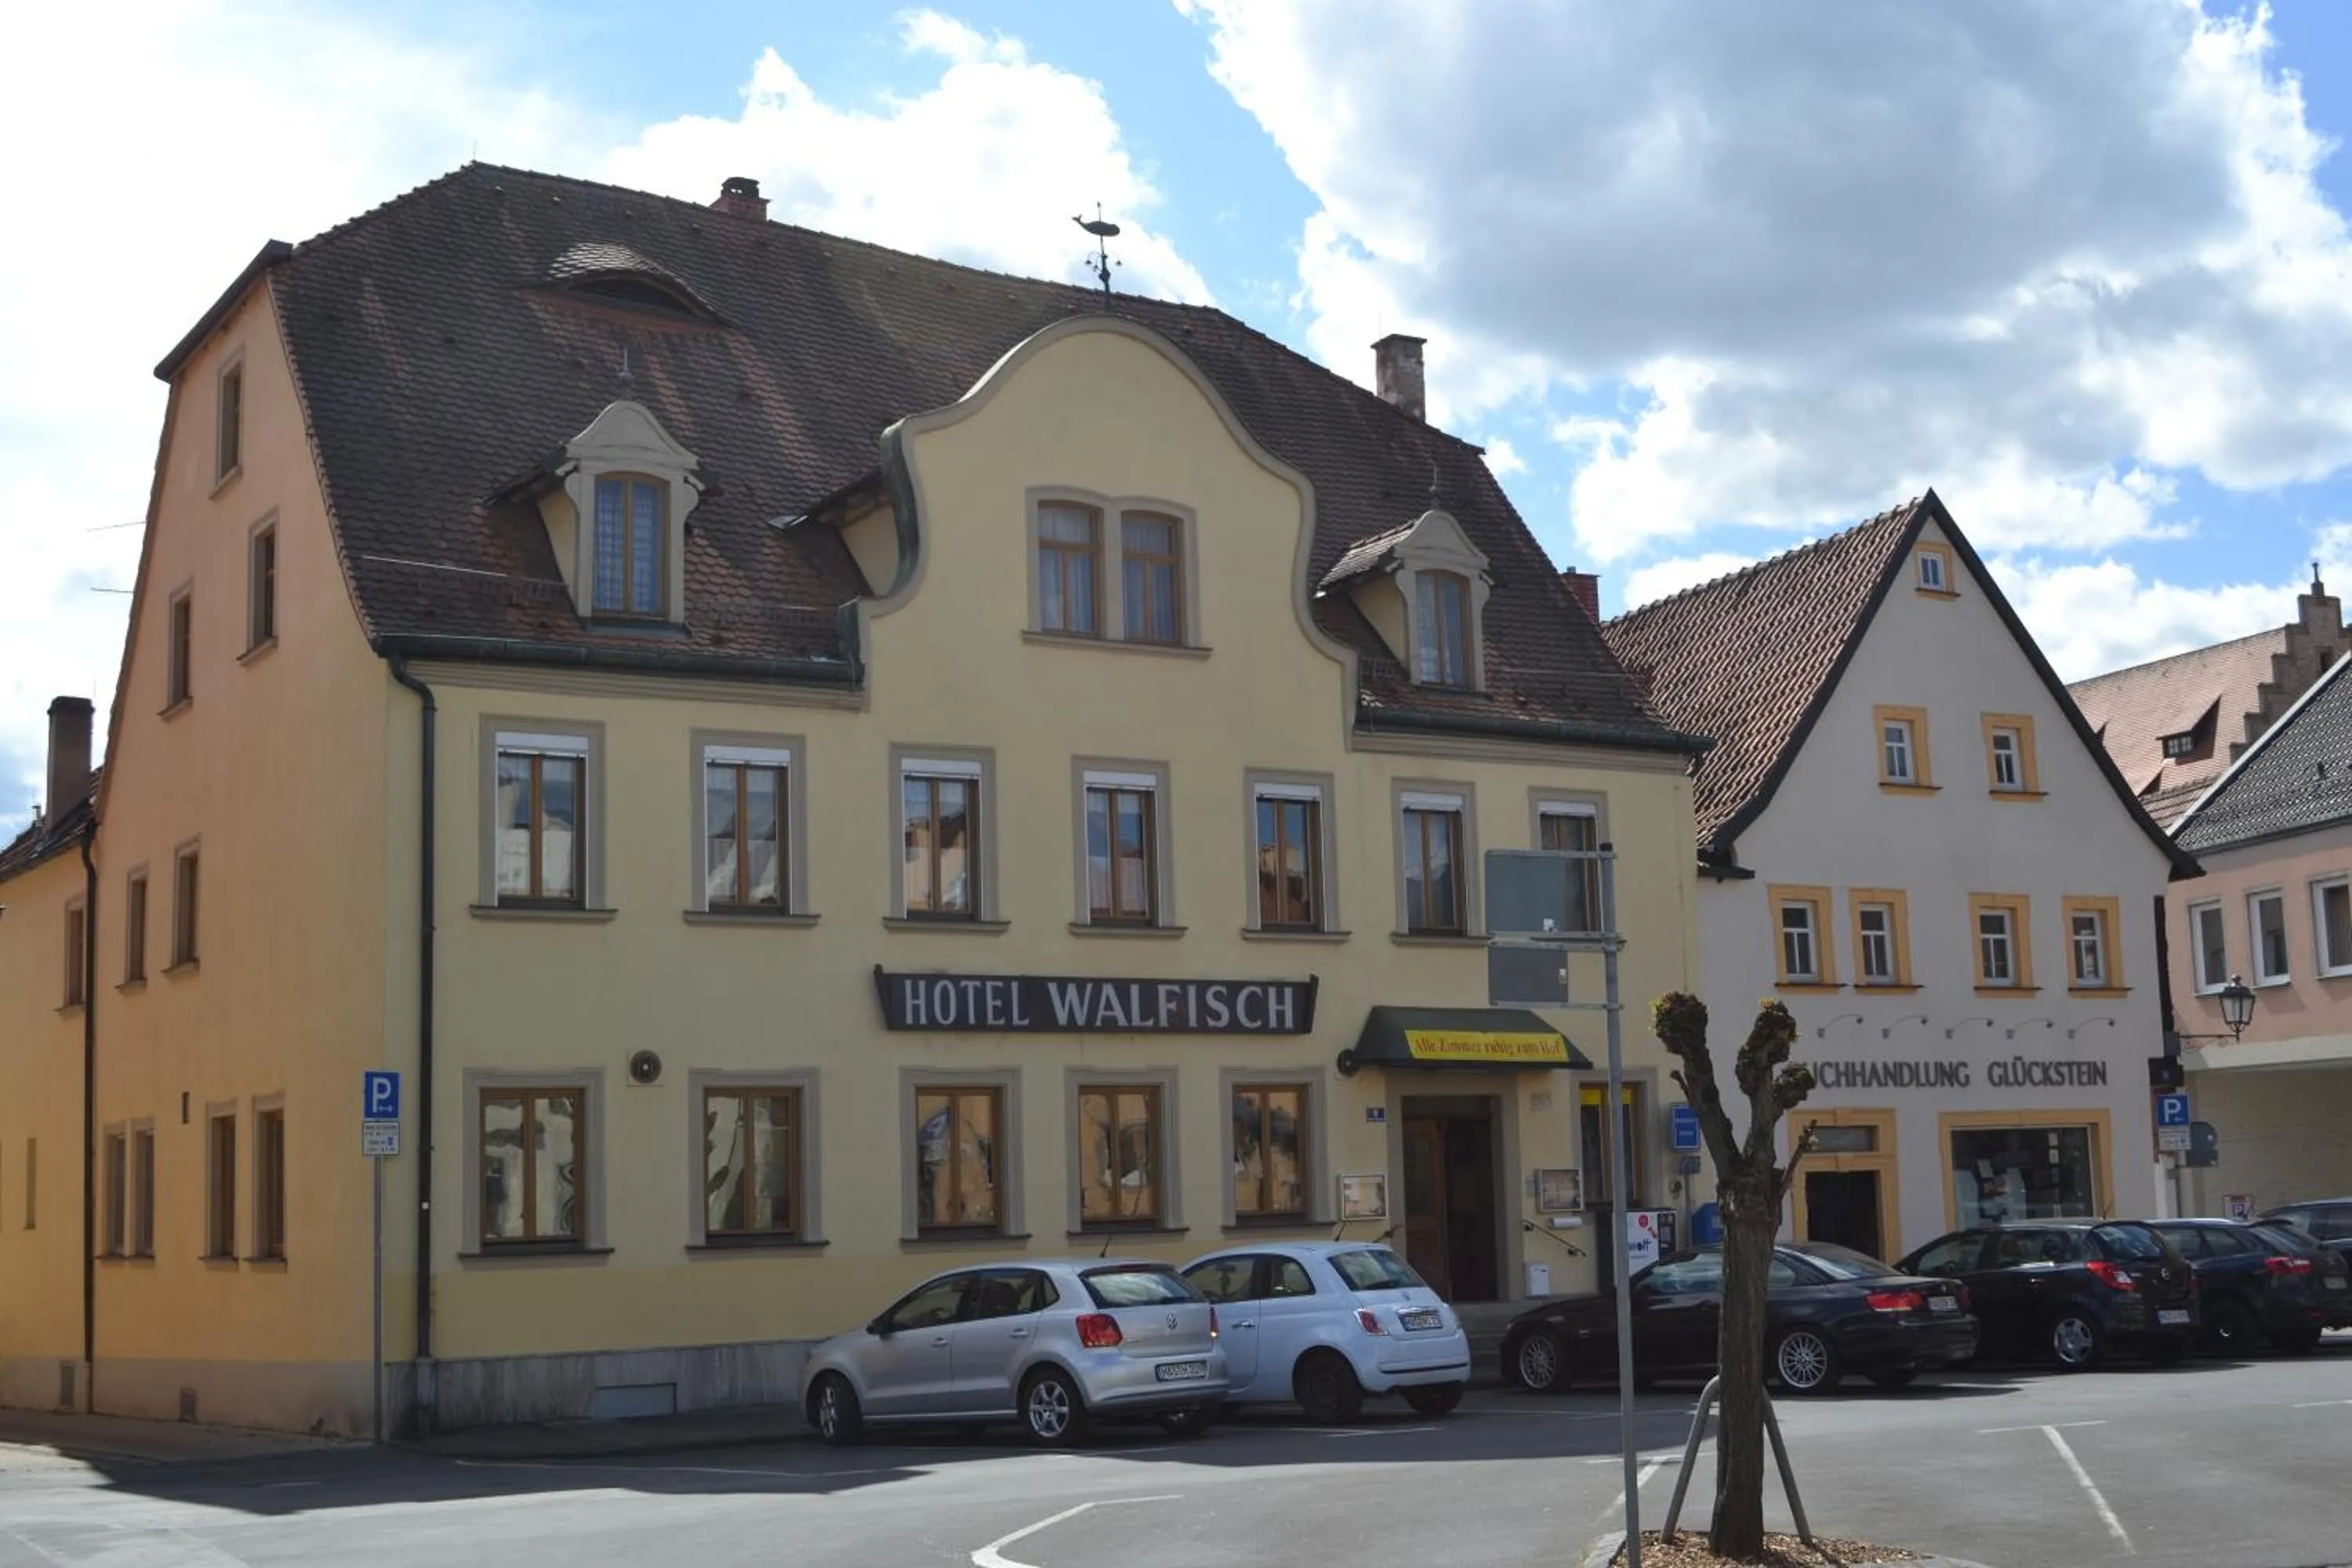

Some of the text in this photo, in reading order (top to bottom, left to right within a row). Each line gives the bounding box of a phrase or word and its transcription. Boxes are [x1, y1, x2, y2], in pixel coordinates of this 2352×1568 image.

[904, 979, 1294, 1029] HOTEL WALFISCH
[1988, 1056, 2107, 1088] GLÜCKSTEIN
[372, 1076, 391, 1112] P
[2164, 1099, 2181, 1123] P
